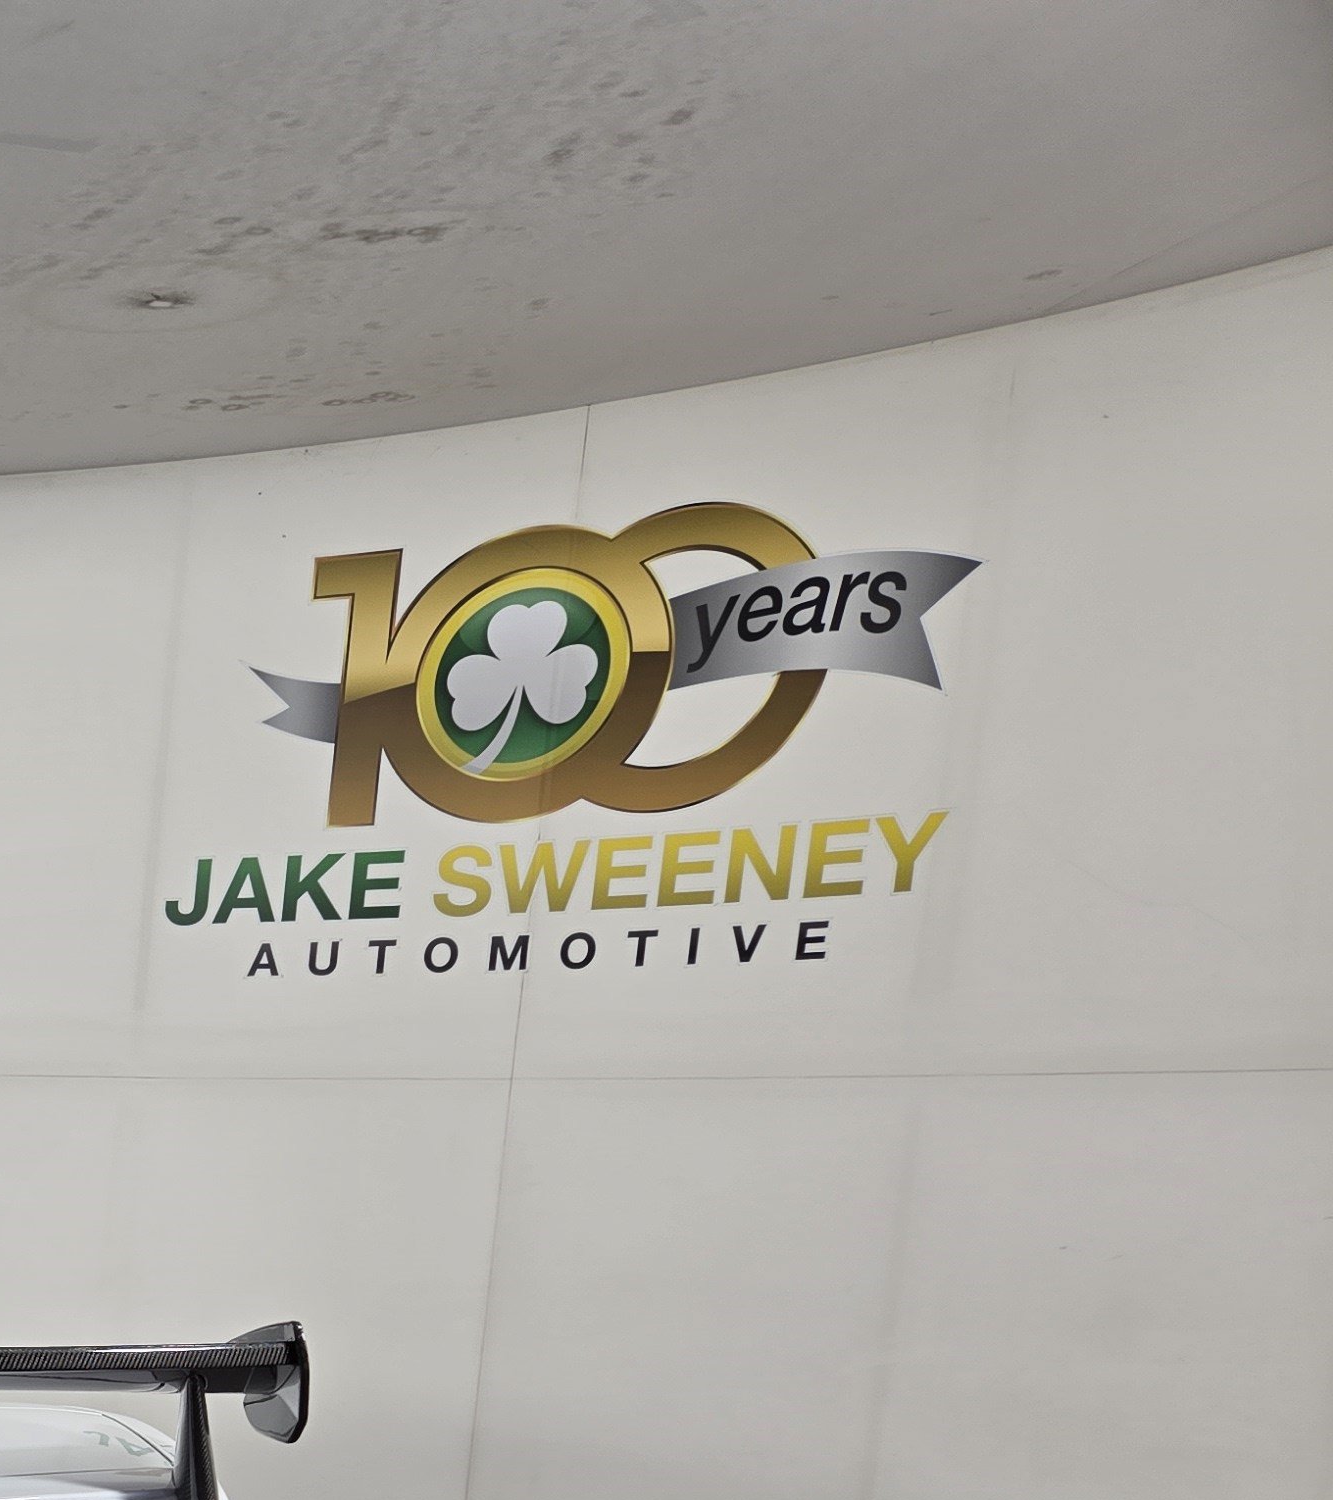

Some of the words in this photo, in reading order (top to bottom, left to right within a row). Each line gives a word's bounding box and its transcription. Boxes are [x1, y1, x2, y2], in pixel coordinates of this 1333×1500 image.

[686, 569, 907, 674] years
[163, 849, 406, 927] JAKE
[432, 811, 950, 918] SWEENEY
[246, 920, 830, 978] AUTOMOTIVE
